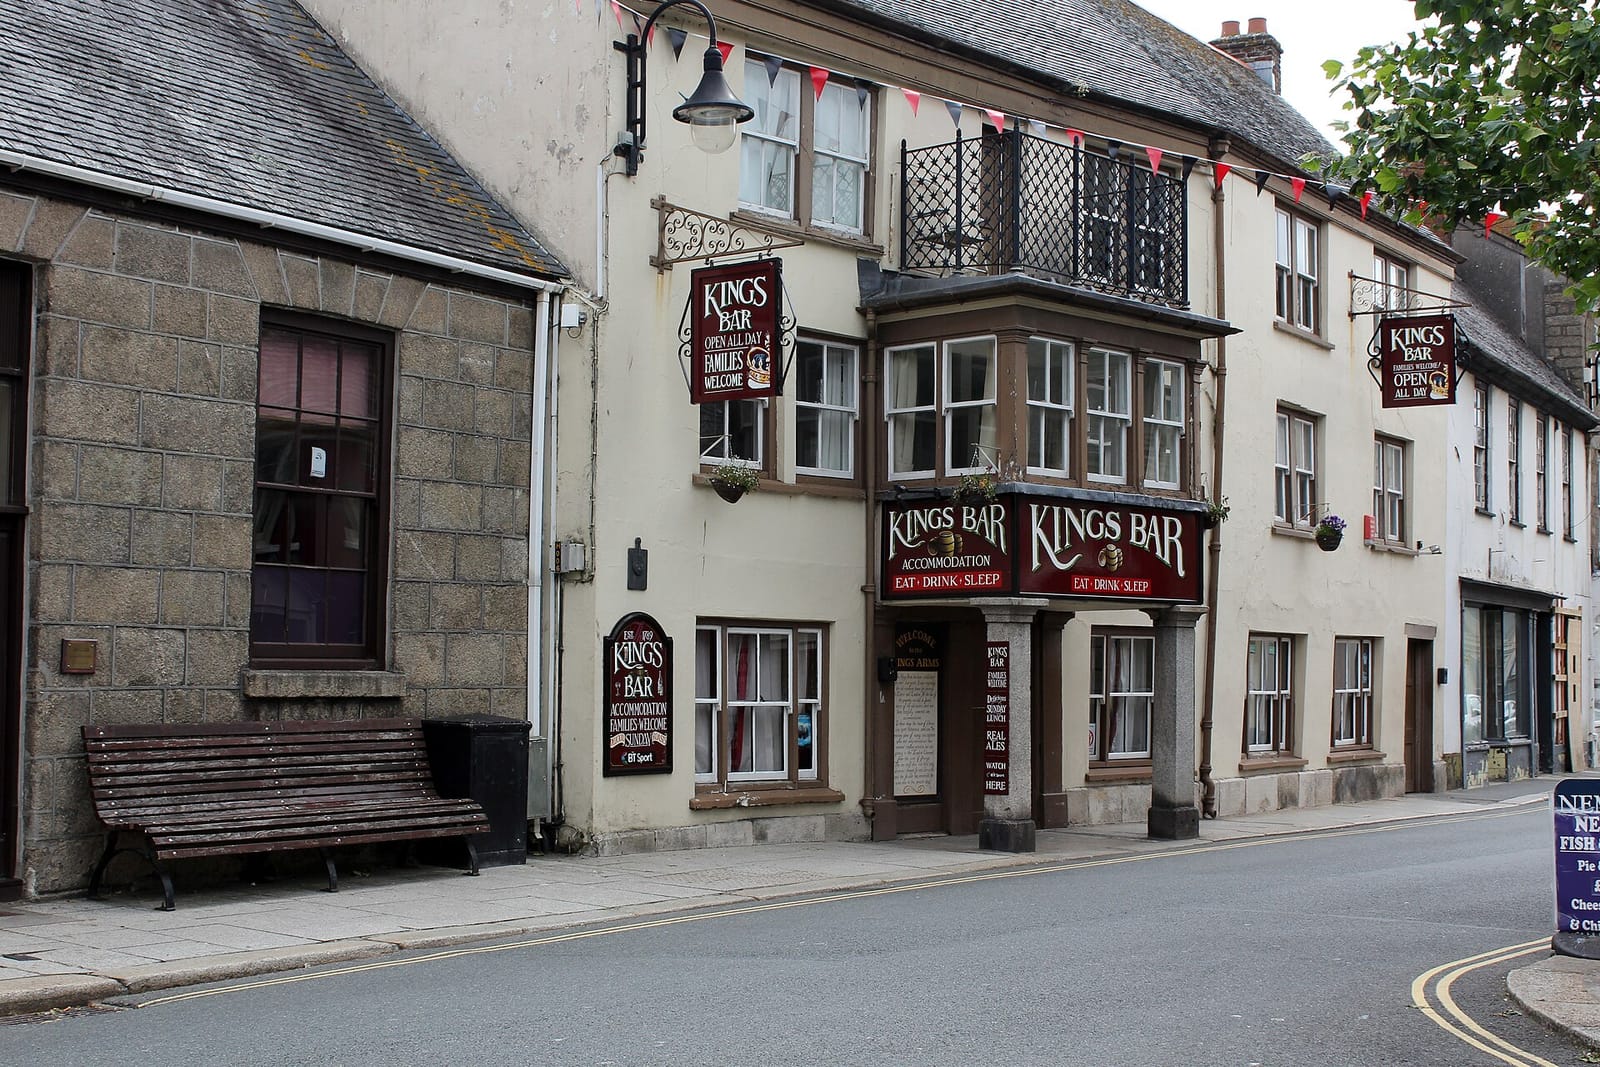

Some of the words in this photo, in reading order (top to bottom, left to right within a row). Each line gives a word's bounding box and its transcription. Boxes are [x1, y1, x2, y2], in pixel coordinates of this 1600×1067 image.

[704, 276, 767, 318] KINGS
[718, 309, 752, 332] BAR
[704, 335, 726, 349] OPEN
[727, 332, 744, 347] ALL
[745, 331, 763, 345] DAY
[1391, 325, 1445, 351] KINGS
[1404, 347, 1432, 361] BAR
[704, 351, 744, 373] FAMILIES
[704, 373, 744, 389] WELCOME
[1394, 372, 1428, 387] OPEN
[1395, 388, 1410, 399] ALL
[1413, 387, 1428, 397] DAY
[888, 506, 955, 561] KINGS
[962, 504, 1008, 556] BAR
[1029, 503, 1122, 574] KINGS
[1129, 512, 1186, 579] BAR
[902, 554, 991, 571] ACCOMMODATION
[895, 576, 916, 589] EAT
[922, 574, 958, 588] DRINK
[964, 573, 1000, 586] SLEEP
[1074, 577, 1090, 590] EAT
[1094, 578, 1120, 592] DRINK
[1123, 580, 1149, 592] SLEEP
[896, 629, 936, 649] WELCOME
[614, 641, 663, 674] KINGS
[987, 646, 1008, 658] KINGS
[897, 658, 915, 667] INGS
[916, 657, 940, 668] ARMS
[990, 657, 1005, 667] BAR
[624, 675, 653, 697] BAR
[610, 702, 667, 717] ACCOMMODATION
[986, 704, 1007, 713] SUNDAY
[610, 718, 638, 732] FAMILIES
[638, 717, 667, 731] WELCOME
[986, 714, 1006, 722] LUNCH
[986, 730, 1007, 741] REAL
[985, 739, 1006, 751] ALES
[627, 752, 636, 763] BT
[636, 752, 653, 764] Sport
[985, 761, 1006, 770] WATCH
[985, 780, 1006, 791] HERE
[1559, 836, 1596, 851] FISH
[1577, 859, 1596, 872] Pie
[1571, 898, 1600, 910] Chee
[1569, 918, 1580, 930] &
